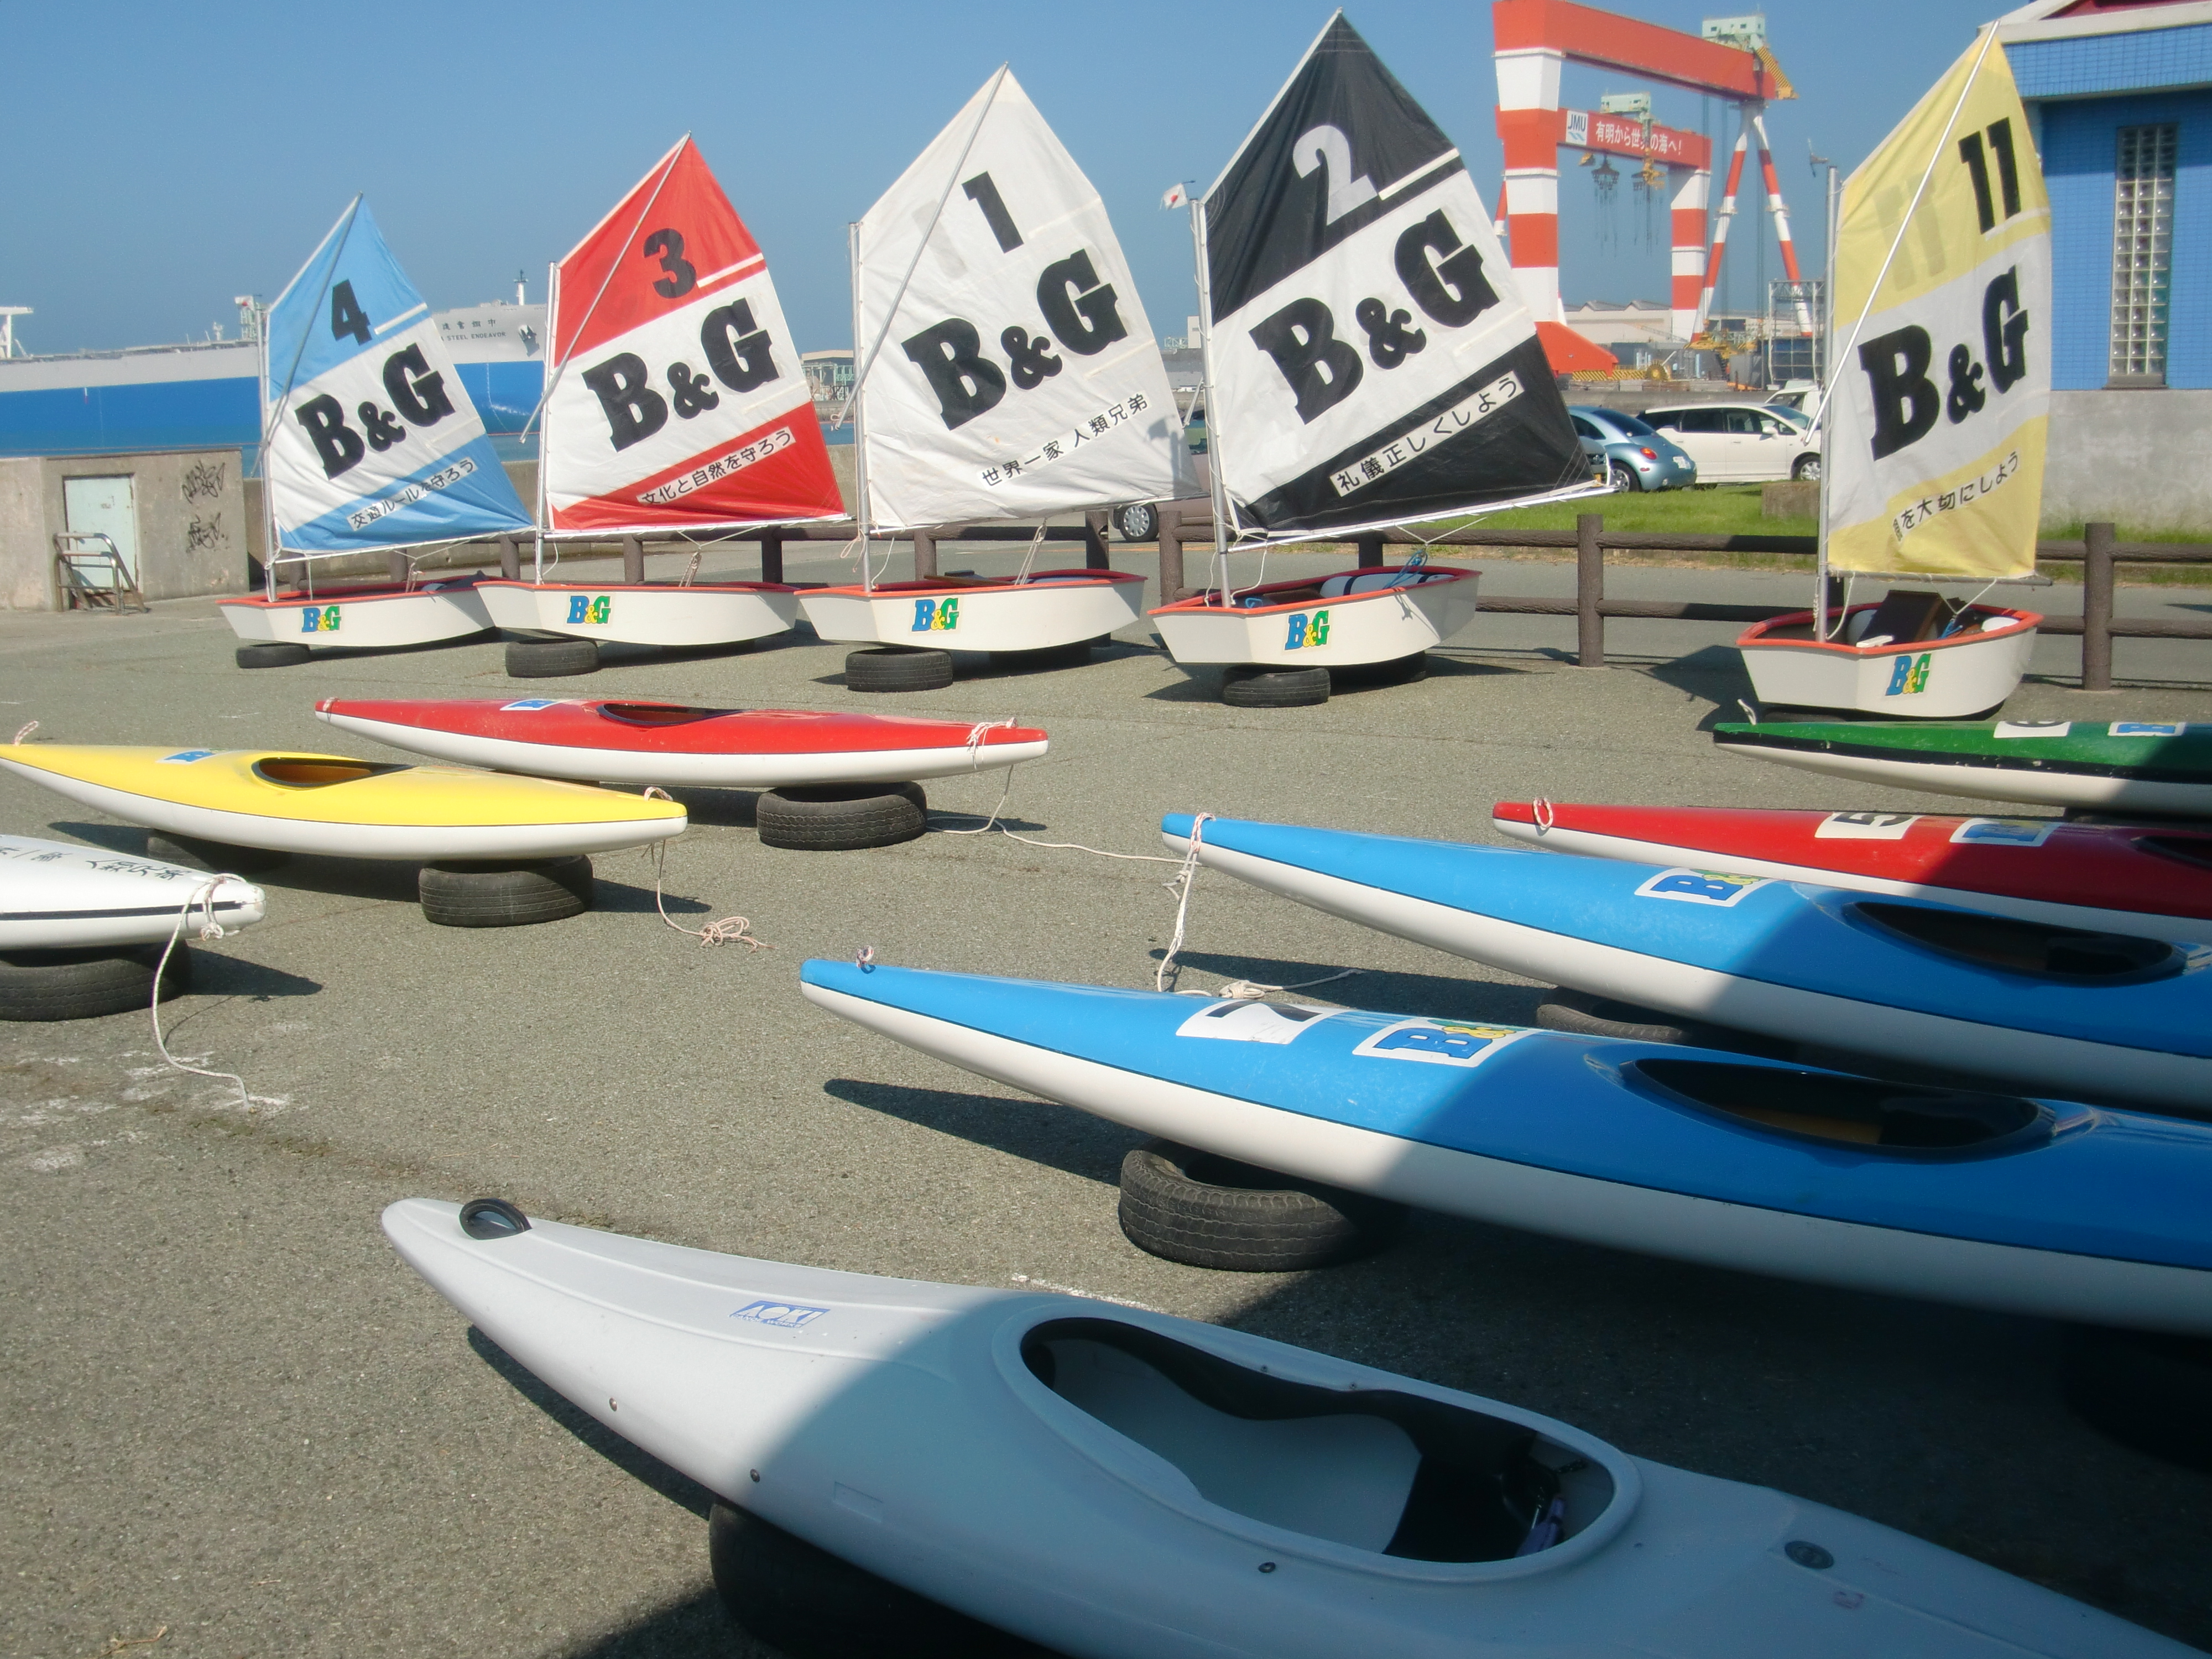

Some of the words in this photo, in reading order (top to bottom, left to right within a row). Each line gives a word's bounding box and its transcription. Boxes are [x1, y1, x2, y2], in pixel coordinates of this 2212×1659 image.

[1568, 114, 1587, 132] JMU
[1595, 121, 1682, 155] 有明から世の海へ!
[961, 170, 1024, 254] 1
[1293, 125, 1378, 226] 2
[1958, 116, 2021, 235] 11
[643, 228, 697, 299] 3
[331, 279, 372, 346] 4
[901, 248, 1128, 431] B&G
[1248, 208, 1500, 425] B&G
[581, 298, 780, 452] B&G
[1858, 264, 2029, 461] B&G
[294, 342, 456, 481] B&G
[982, 440, 1065, 487] 世界一家
[1074, 393, 1148, 448] 人類兄弟
[1337, 377, 1517, 492] 礼儀正しくしよう
[351, 460, 473, 529] 交通ルールを守ろう
[641, 430, 791, 504] 文化と自然を守ろう
[301, 606, 341, 633] B&G
[567, 596, 611, 624] B&G
[911, 597, 959, 632] B&G
[1285, 610, 1330, 650] B&G
[1885, 653, 1932, 696] B&G
